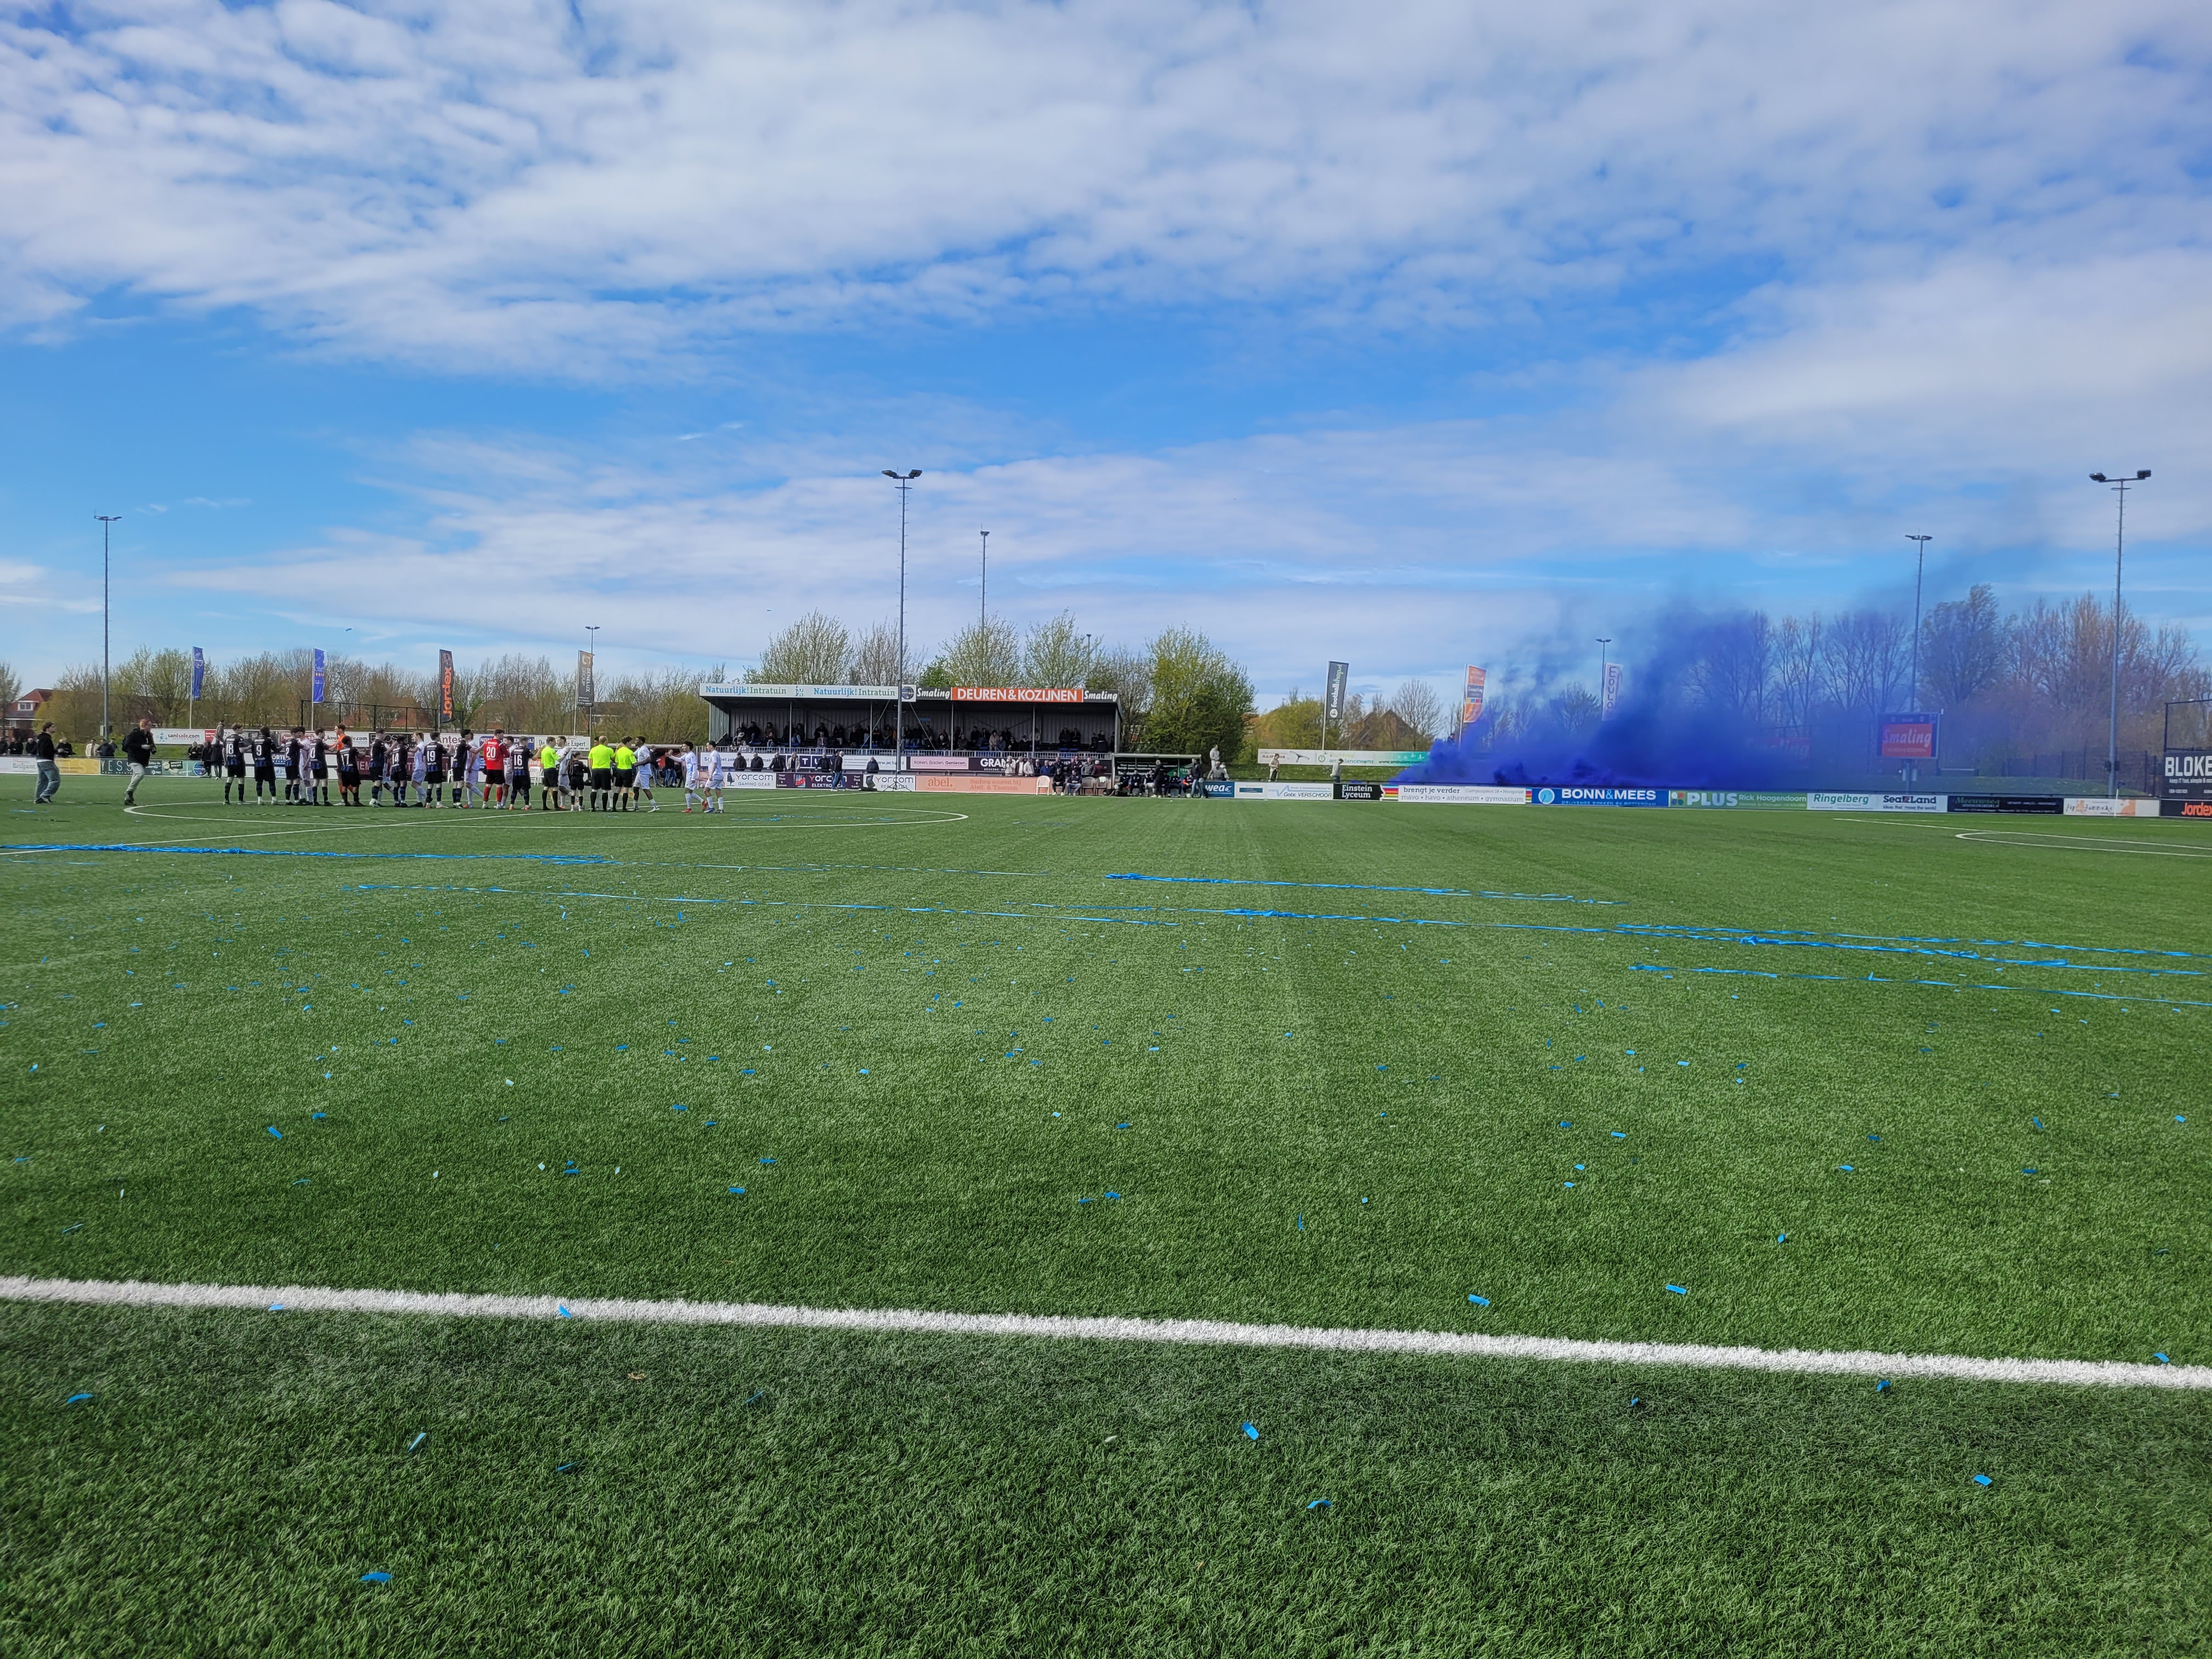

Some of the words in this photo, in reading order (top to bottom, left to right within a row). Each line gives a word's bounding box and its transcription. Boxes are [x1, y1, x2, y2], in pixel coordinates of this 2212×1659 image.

[706, 686, 749, 695] Natuurlijk!
[814, 687, 857, 697] Natuurlijk!
[859, 688, 895, 696] Intratuin
[917, 687, 951, 699] Smaling
[1084, 690, 1118, 702] Smaling
[1882, 728, 1932, 748] Smaling
[226, 743, 234, 754] 18
[256, 744, 262, 756] 9
[486, 746, 496, 758] 20
[342, 753, 349, 767] 17
[427, 750, 436, 762] 19
[514, 754, 522, 766] 16
[928, 777, 953, 787] abel.
[1342, 791, 1371, 799] Lyceum
[1561, 788, 1656, 800] BONN&MEES
[1687, 792, 1738, 806] PLUS
[1814, 793, 1869, 805] Ringelberg
